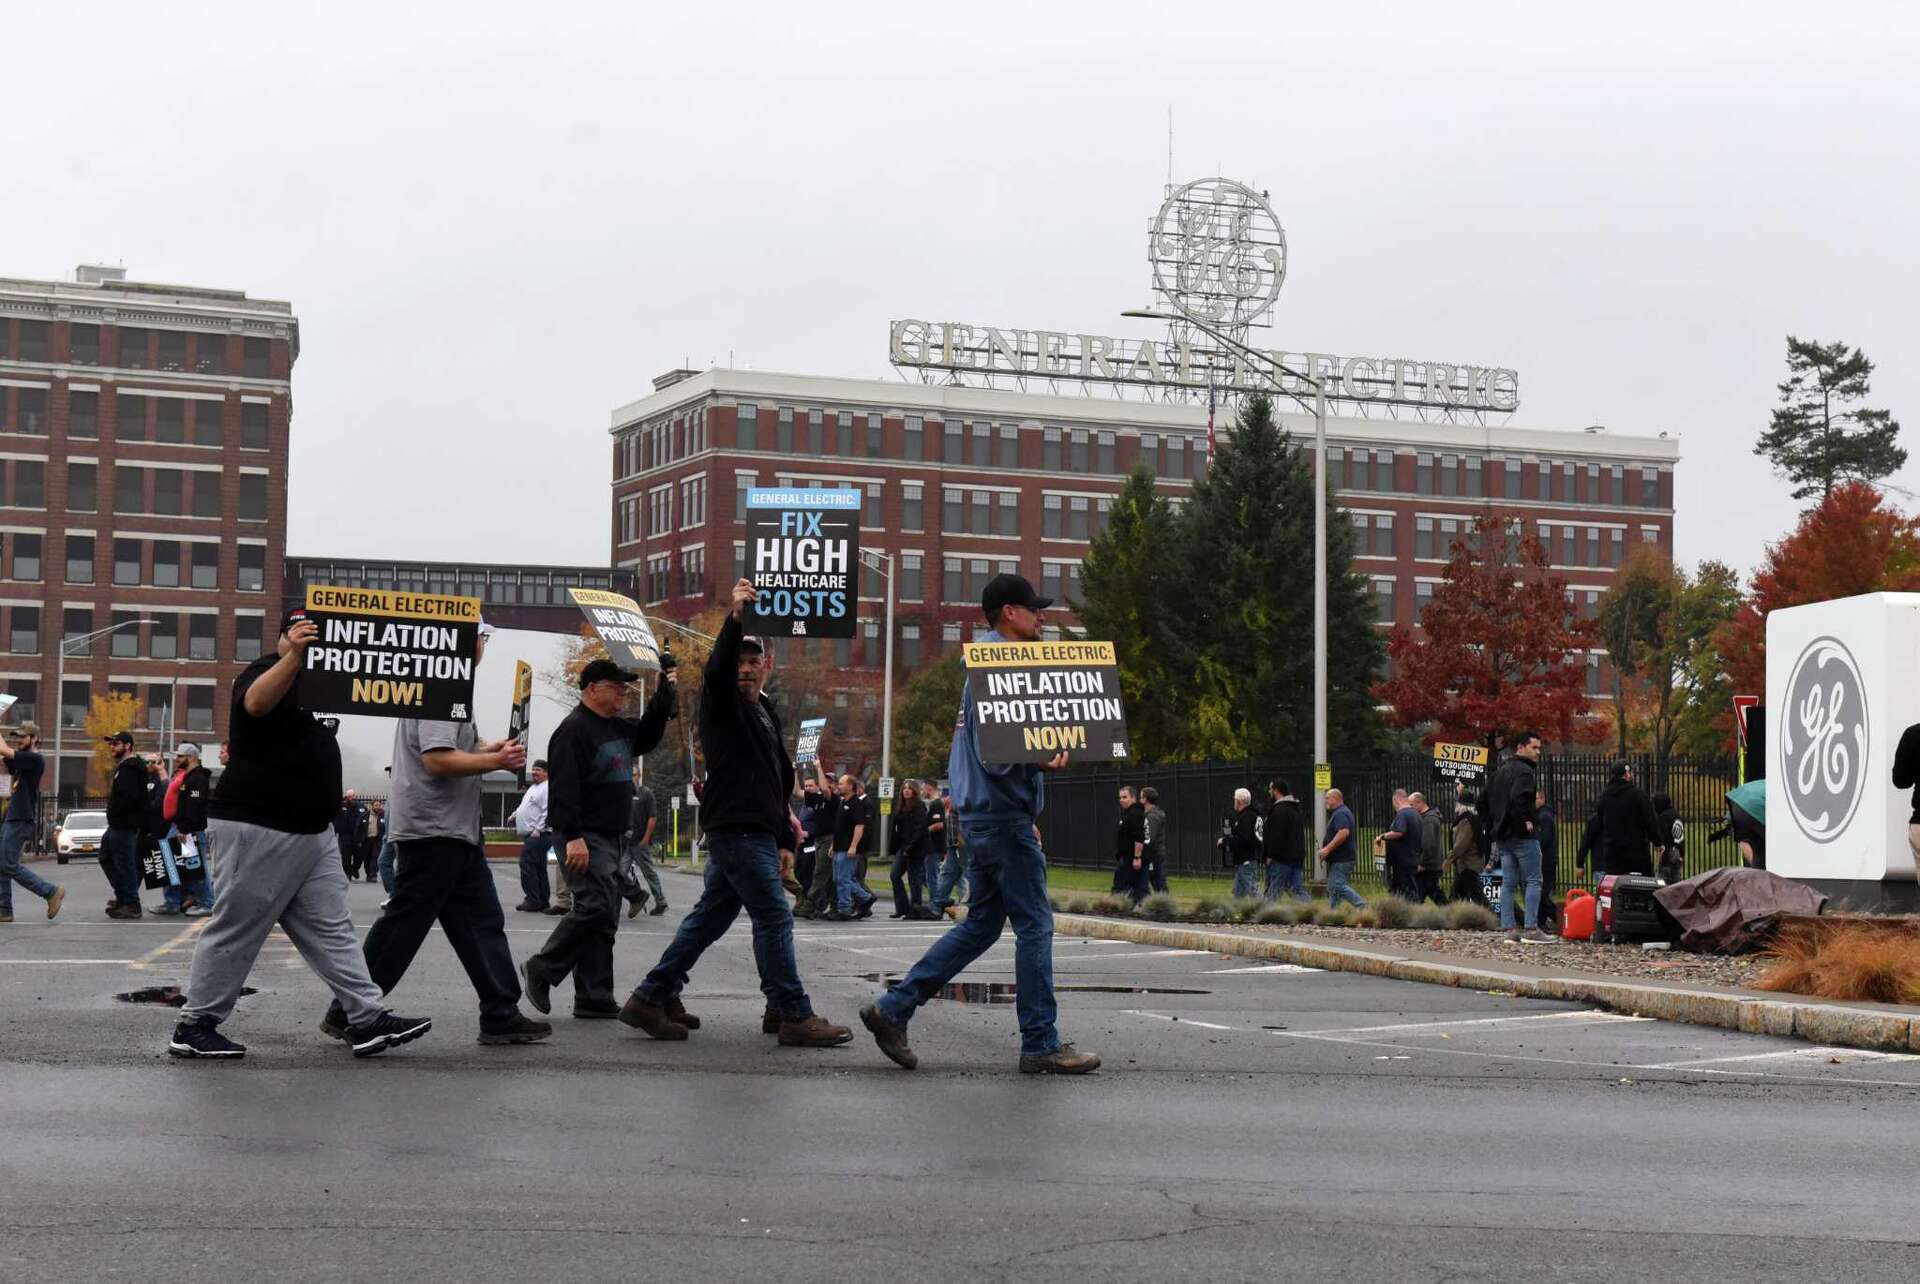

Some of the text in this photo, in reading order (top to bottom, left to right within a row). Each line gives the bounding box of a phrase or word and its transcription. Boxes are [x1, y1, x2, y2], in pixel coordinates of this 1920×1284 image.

[890, 317, 1519, 409] GENERAL ELECTRIC
[752, 493, 856, 506] GENERAL ELECTRIC:
[781, 511, 823, 537] FIX
[755, 537, 848, 573] HIGH
[754, 573, 847, 589] HEALTHCARE
[312, 590, 477, 618] GENERAL ELECTRIC:
[754, 589, 847, 618] COSTS
[325, 618, 458, 651] INFLATION
[306, 646, 472, 681] PROTECTION
[970, 645, 1112, 663] GENERAL ELECTRIC:
[352, 678, 424, 706] NOW!
[987, 671, 1104, 696] INFLATION
[977, 698, 1122, 724] PROTECTION
[798, 735, 819, 749] HIGH
[1023, 725, 1087, 751] NOW!
[1441, 744, 1481, 761] STOP
[1434, 760, 1484, 773] OUTSOURCING
[1441, 768, 1476, 779] OUR JOBS
[143, 857, 154, 875] WE
[152, 850, 166, 879] WANT
[1483, 885, 1501, 898] GH
